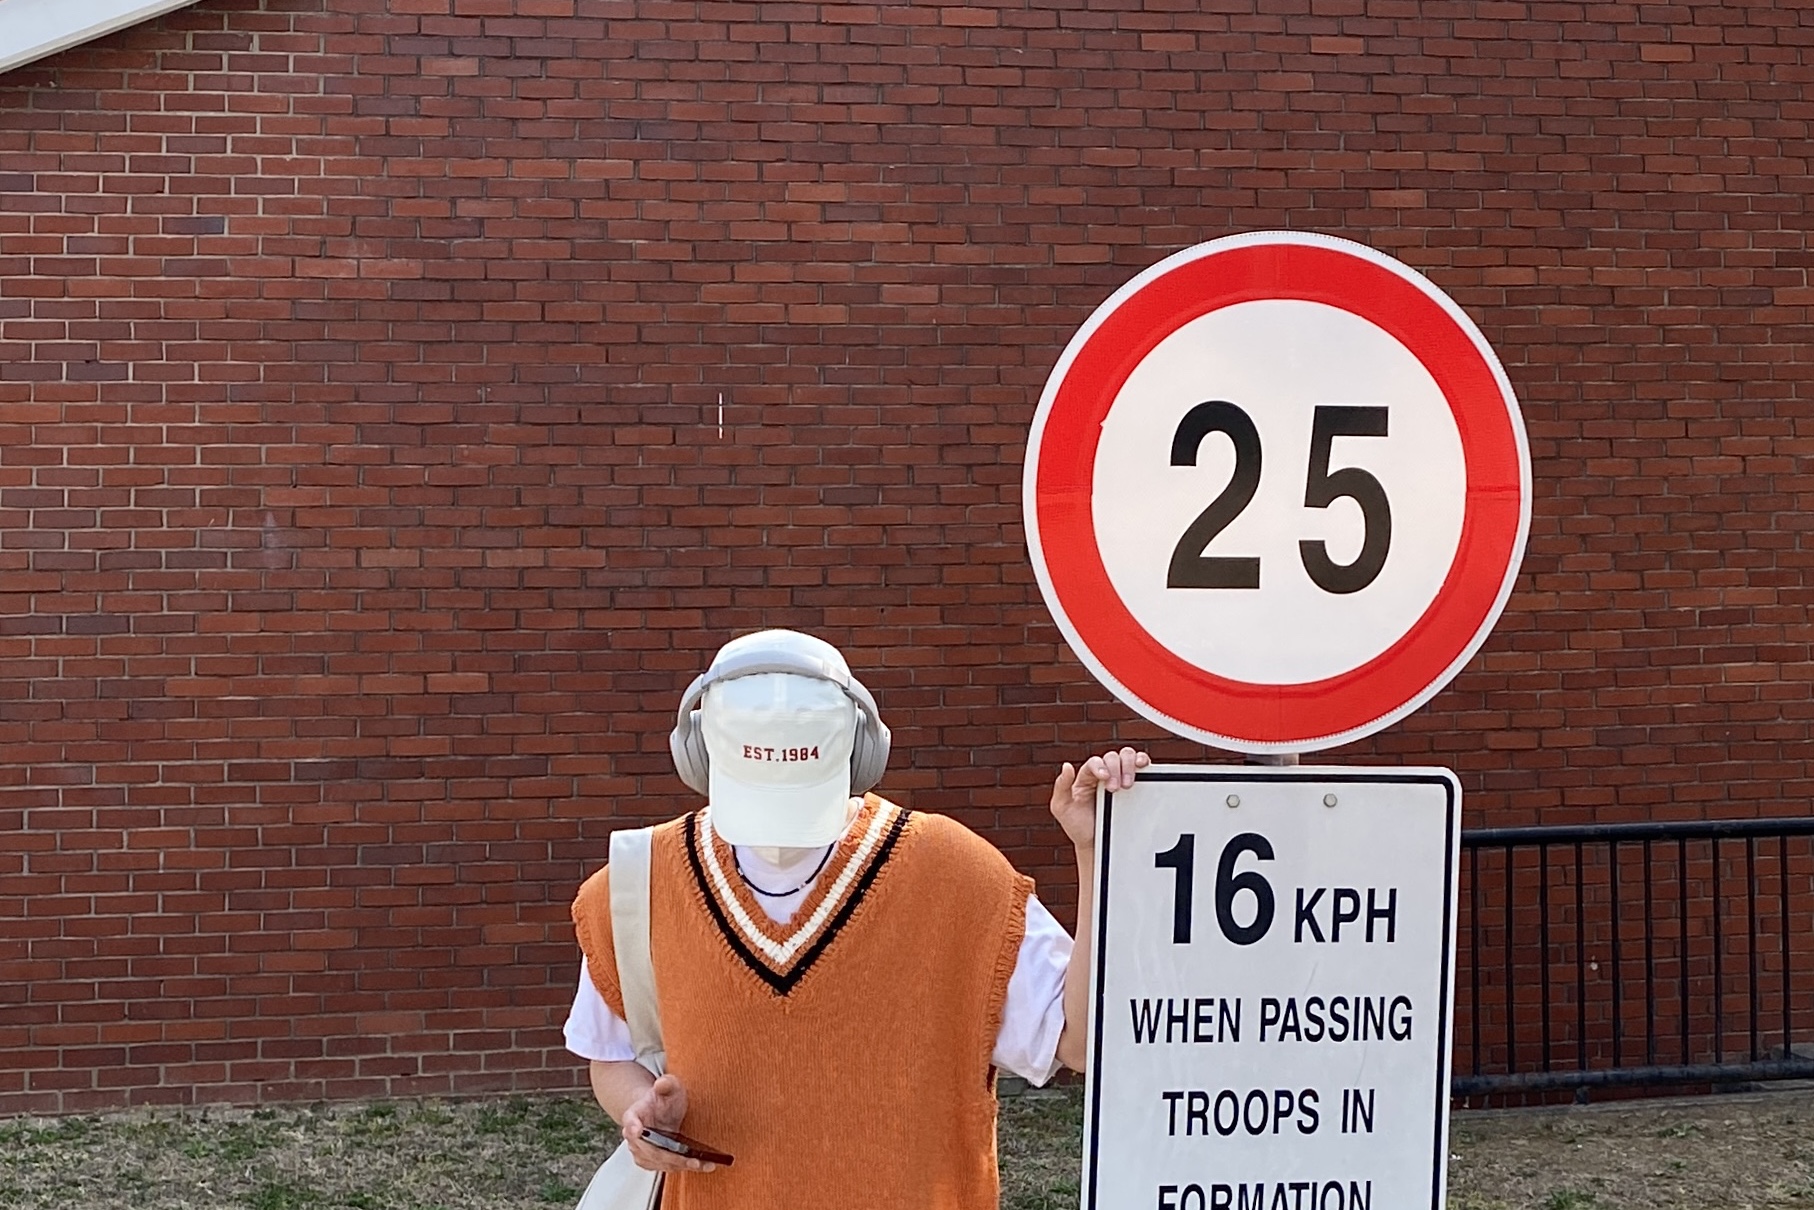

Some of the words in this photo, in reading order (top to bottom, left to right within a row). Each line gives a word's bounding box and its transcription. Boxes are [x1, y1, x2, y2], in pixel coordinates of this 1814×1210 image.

[1166, 400, 1392, 595] 25
[743, 745, 819, 762] EST.1984
[1154, 832, 1275, 946] 16
[1294, 887, 1397, 943] KPH
[1129, 997, 1242, 1044] WHEN
[1259, 995, 1413, 1043] PASSING
[1162, 1088, 1320, 1136] TROOPS
[1341, 1088, 1375, 1134] IN
